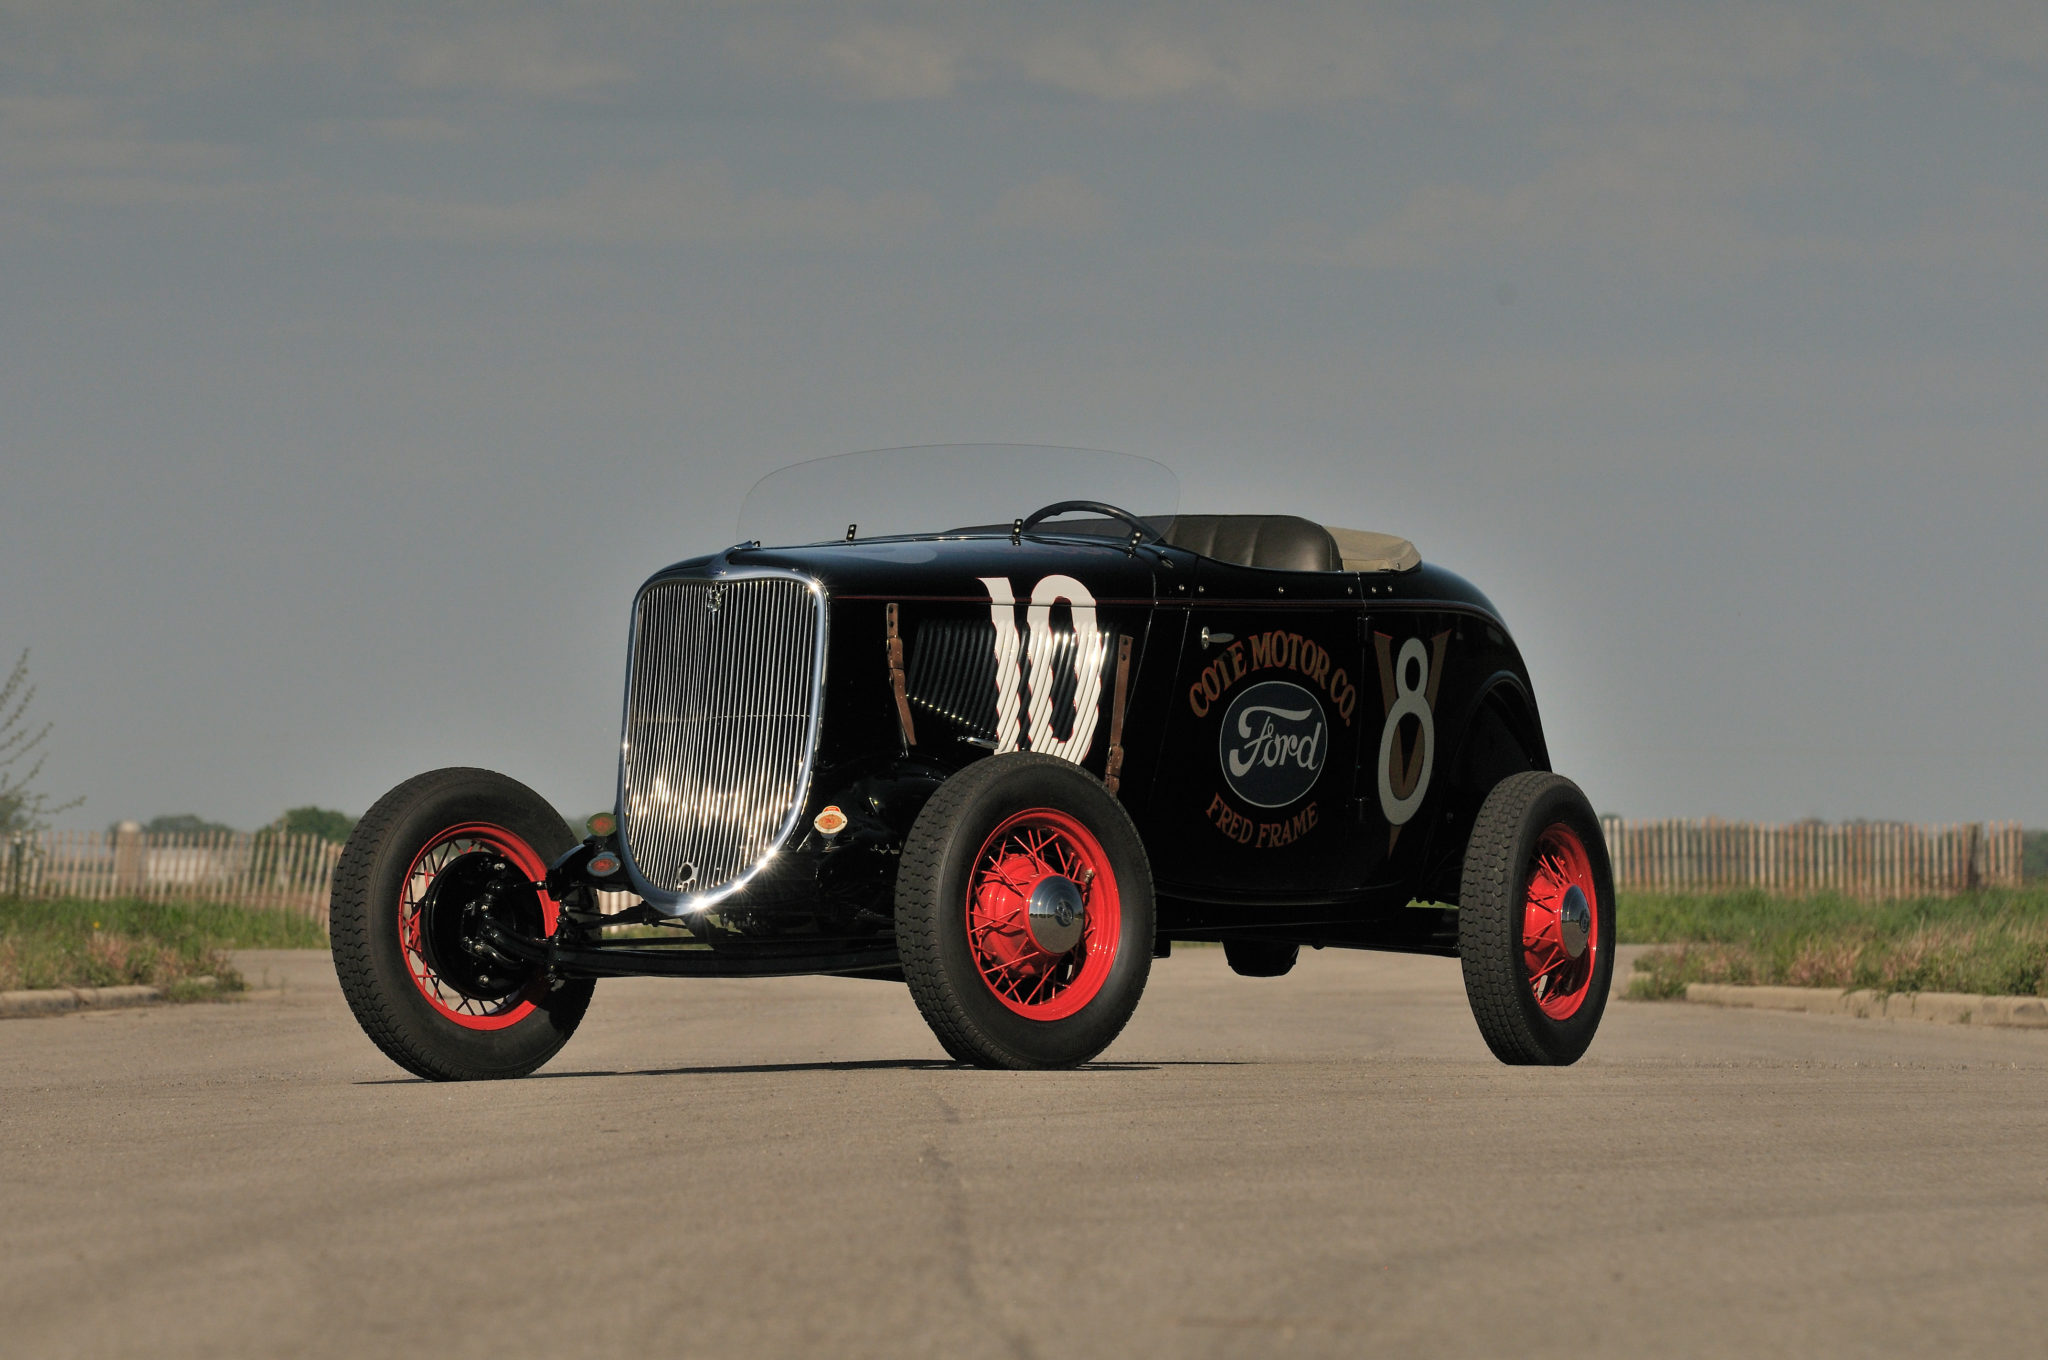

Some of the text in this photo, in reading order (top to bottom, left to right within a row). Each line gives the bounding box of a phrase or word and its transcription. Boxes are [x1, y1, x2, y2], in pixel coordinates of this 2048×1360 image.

[976, 574, 1101, 765] 10
[1189, 641, 1247, 717] COTE
[1249, 630, 1330, 690] MOTOR
[1229, 705, 1322, 777] Ford
[1205, 792, 1319, 848] FRED FRAME
